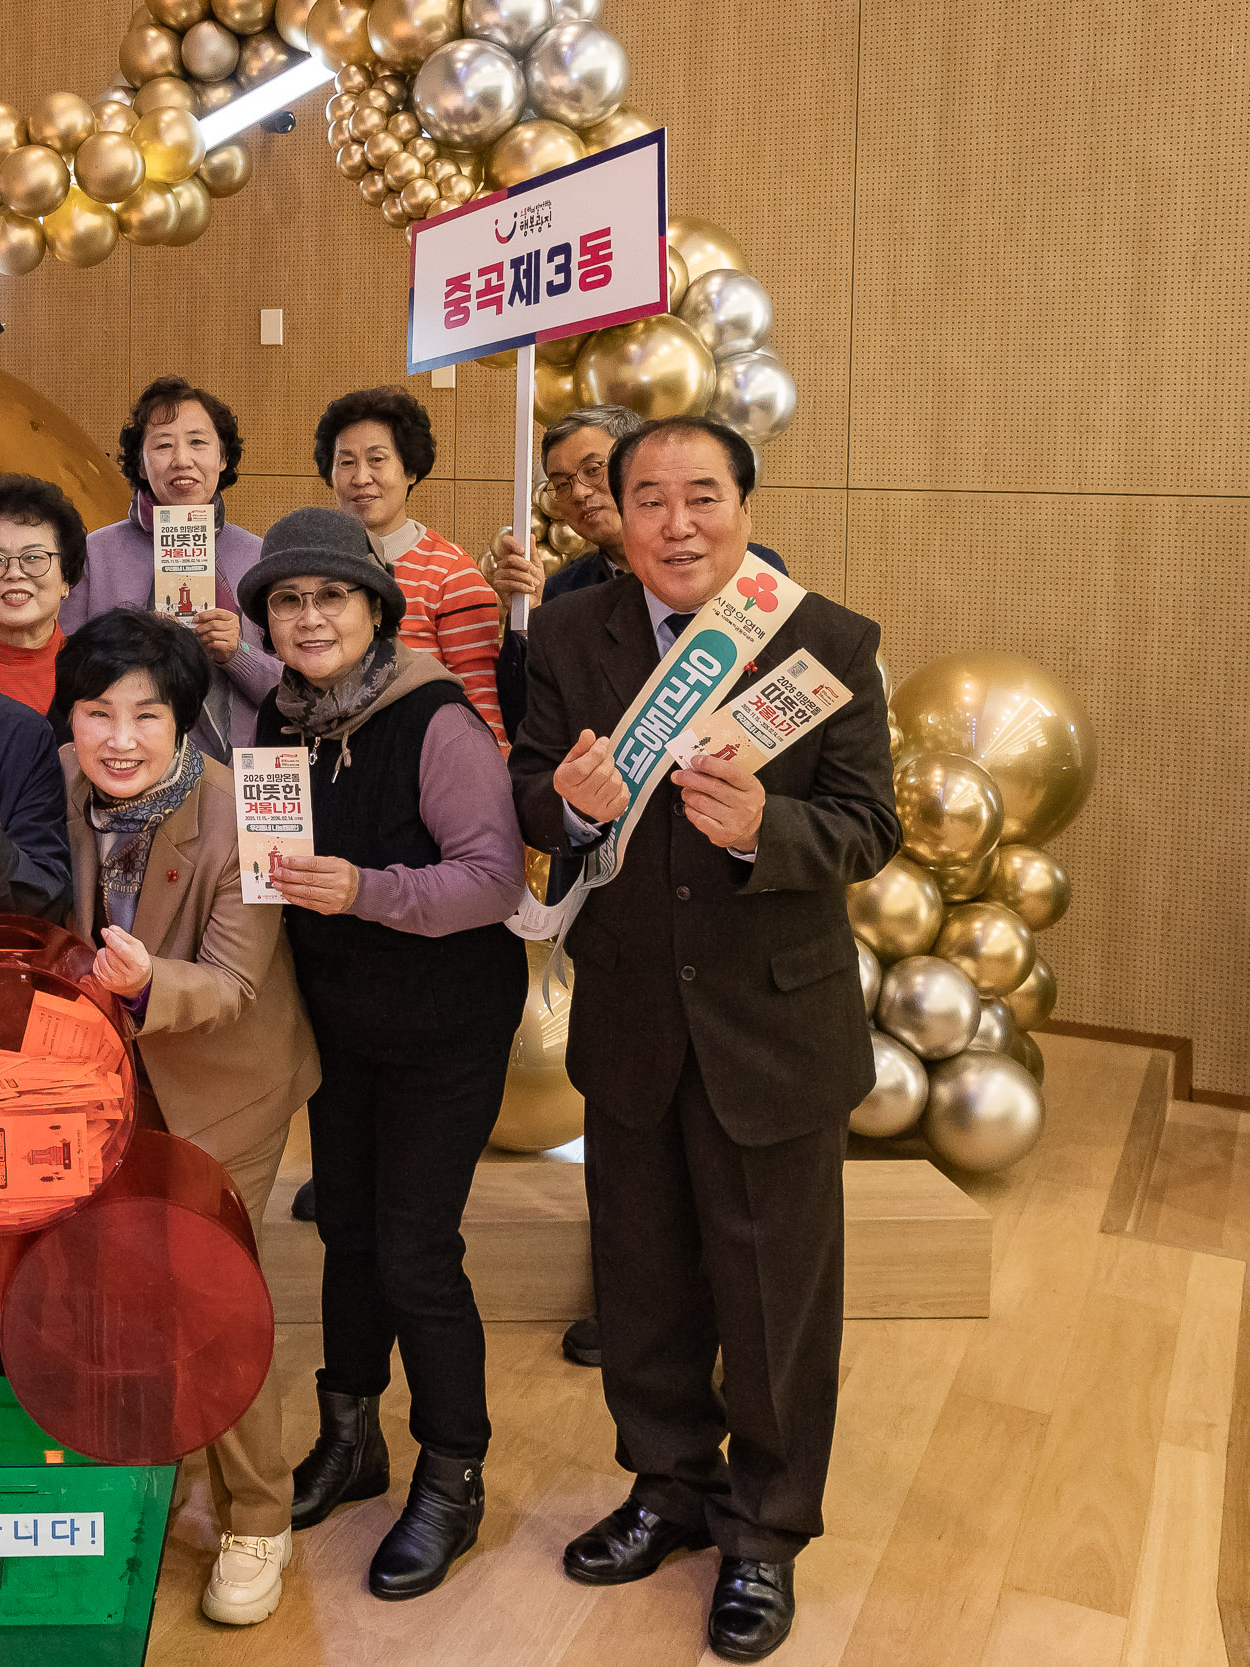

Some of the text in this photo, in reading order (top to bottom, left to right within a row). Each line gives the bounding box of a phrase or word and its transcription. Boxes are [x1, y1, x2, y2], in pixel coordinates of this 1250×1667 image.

[519, 210, 553, 237] 행복광진
[443, 226, 613, 330] 중곡제3동
[161, 533, 207, 548] 따뜻한
[161, 548, 207, 558] 겨울나기
[713, 596, 766, 640] 사랑의열매
[776, 675, 798, 694] 2026
[615, 648, 722, 785] 우리동네
[748, 694, 797, 737] 겨울나기
[760, 682, 812, 728] 따뜻한
[244, 774, 265, 783] 2026
[243, 783, 302, 801] 따뜻한
[245, 801, 302, 814] 겨울나기
